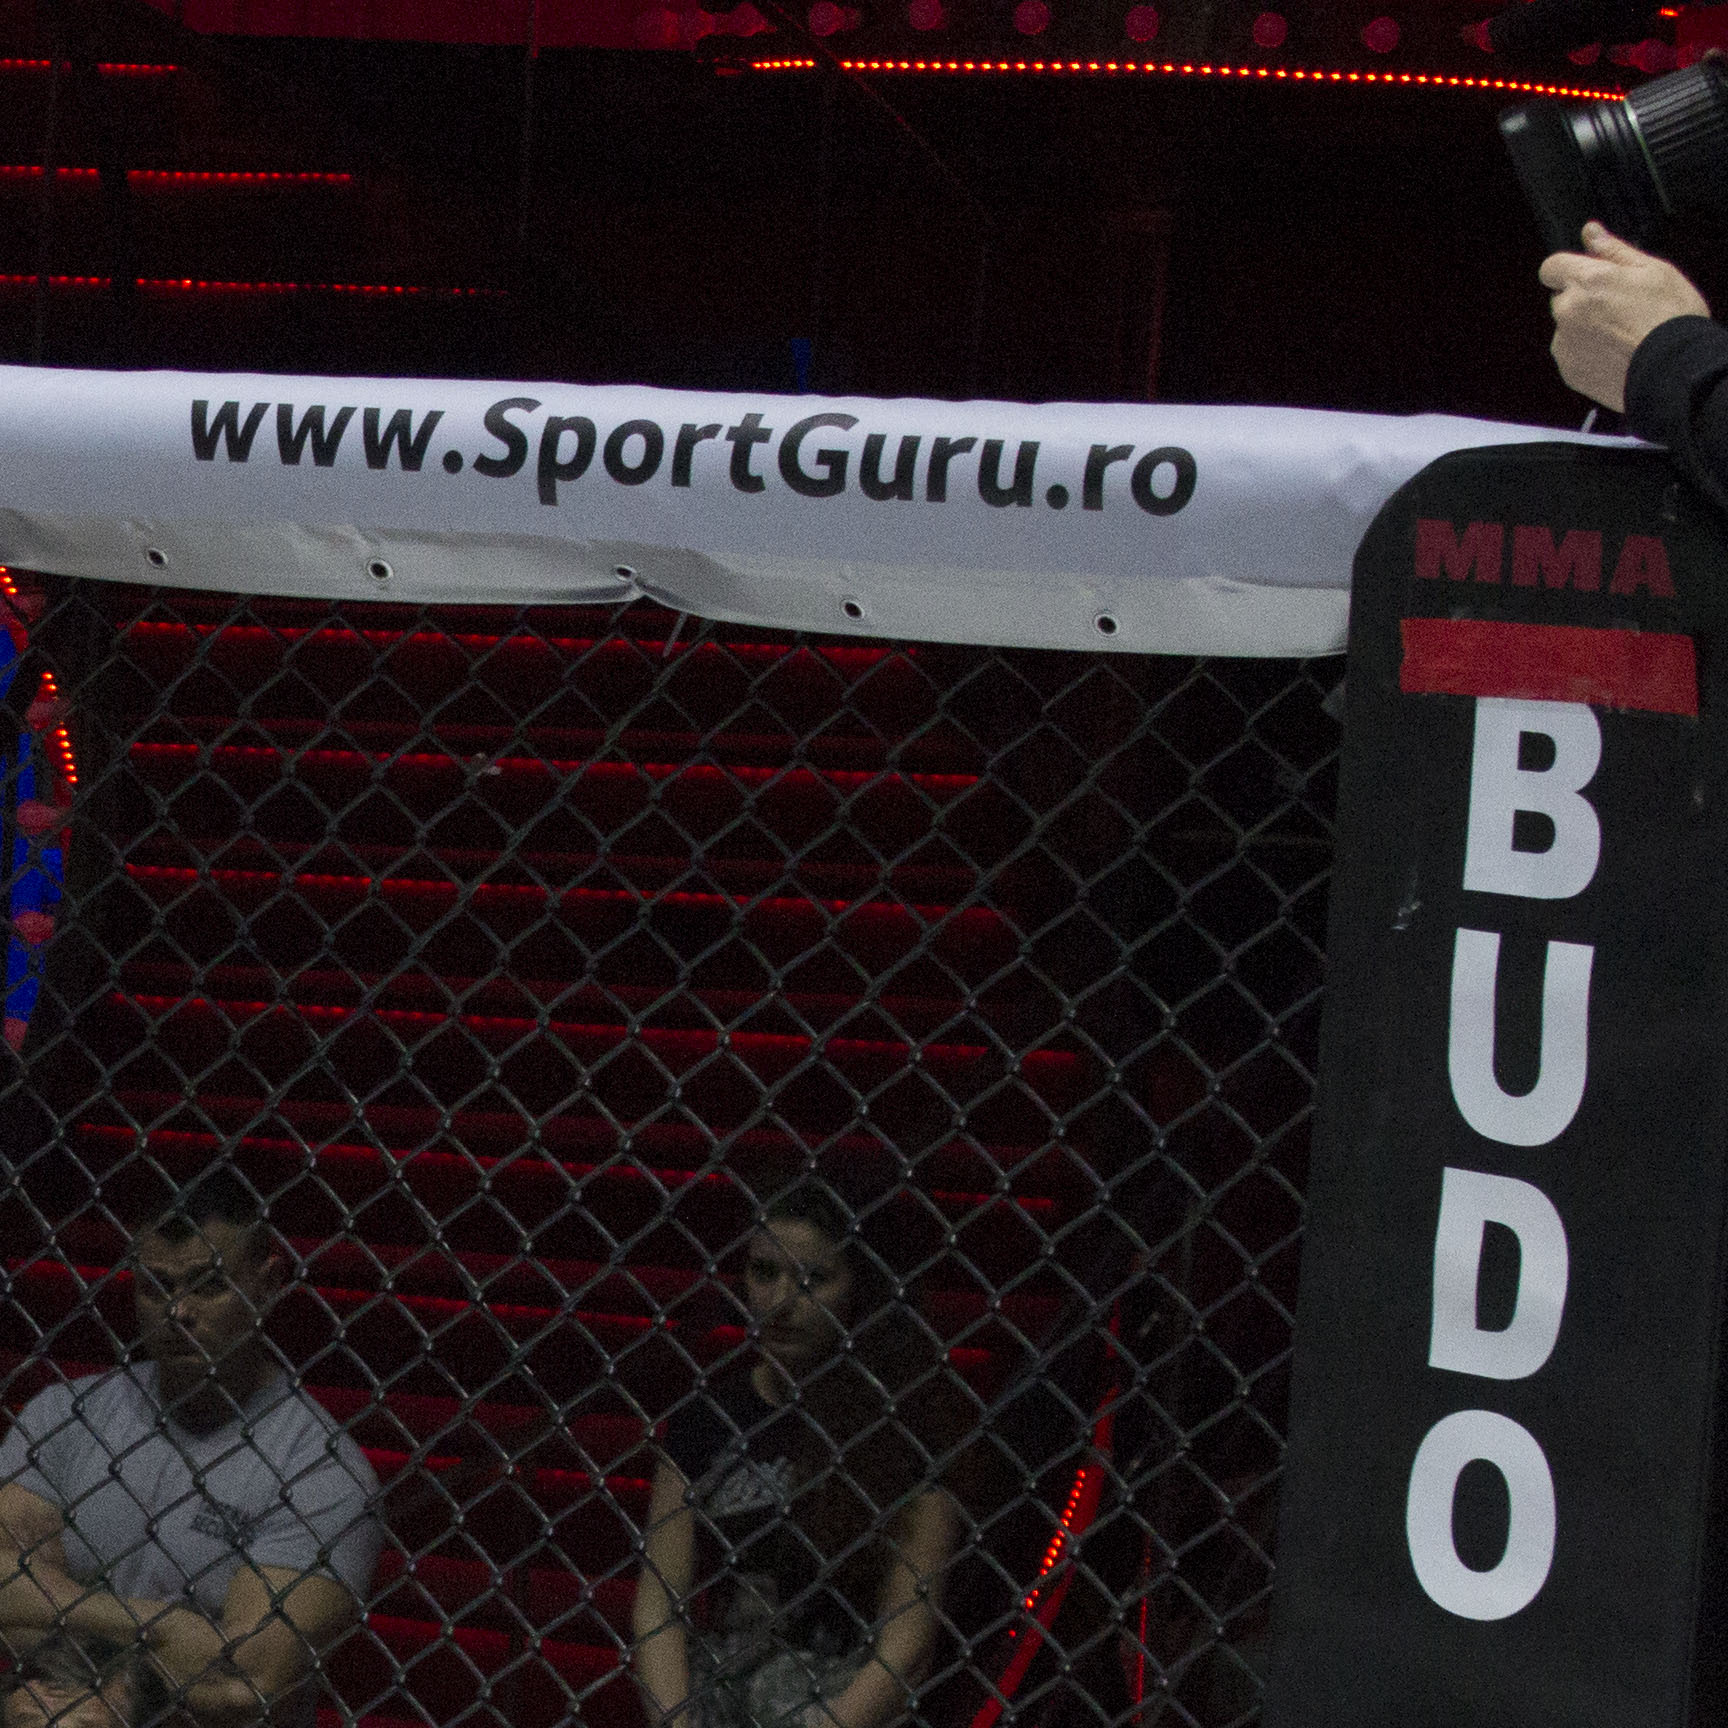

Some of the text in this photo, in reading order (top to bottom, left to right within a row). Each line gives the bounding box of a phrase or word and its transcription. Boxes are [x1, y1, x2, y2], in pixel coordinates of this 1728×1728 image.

[190, 395, 1198, 517] www.SportGuru.ro
[1414, 517, 1677, 598] MMA
[1406, 696, 1603, 1622] BUDO
